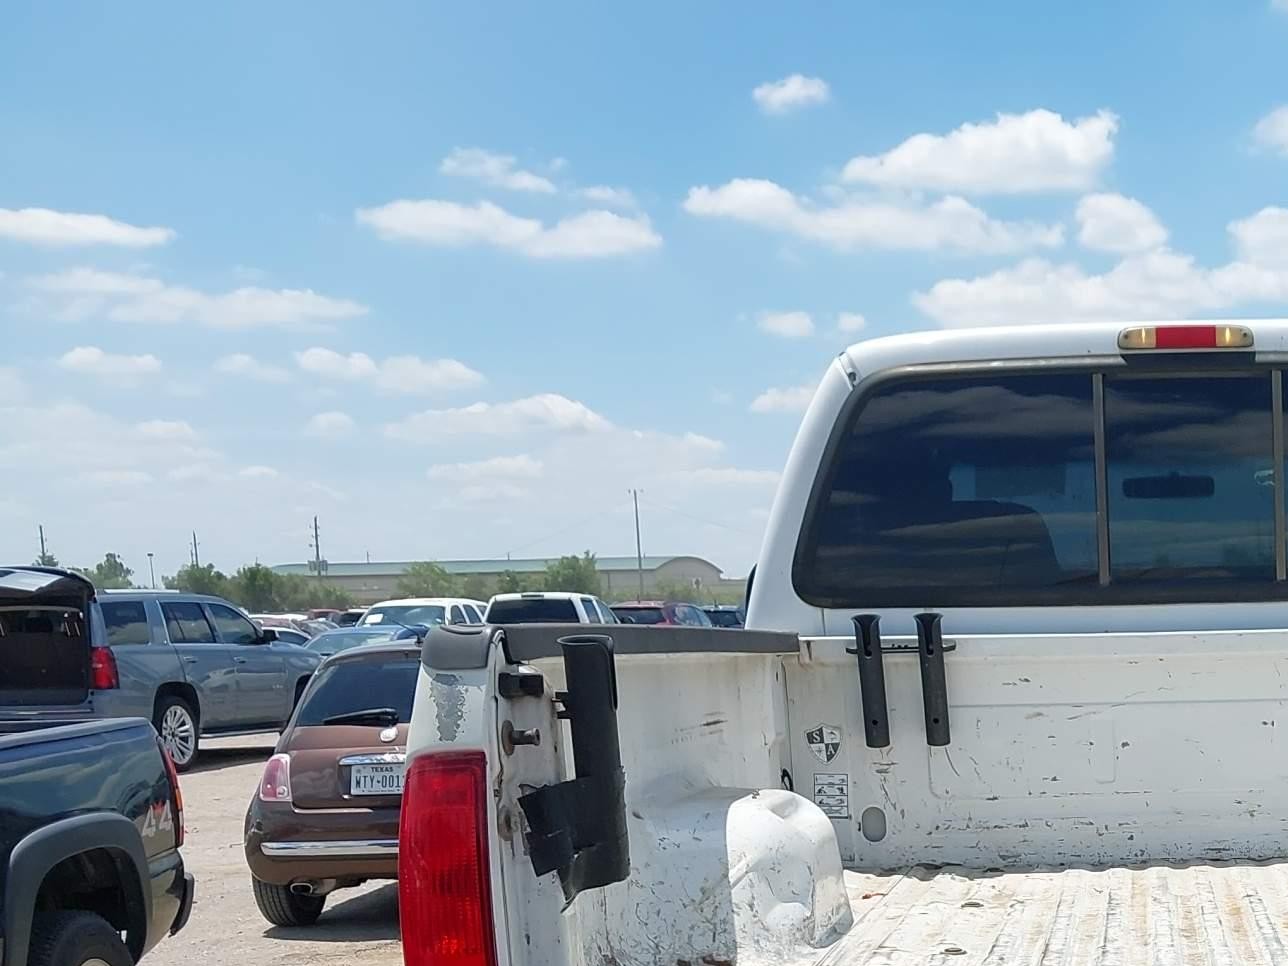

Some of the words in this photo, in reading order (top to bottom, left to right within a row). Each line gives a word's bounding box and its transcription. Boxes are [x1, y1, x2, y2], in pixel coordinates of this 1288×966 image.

[813, 731, 821, 742] S
[827, 743, 836, 755] A
[355, 774, 405, 789] WTY-001
